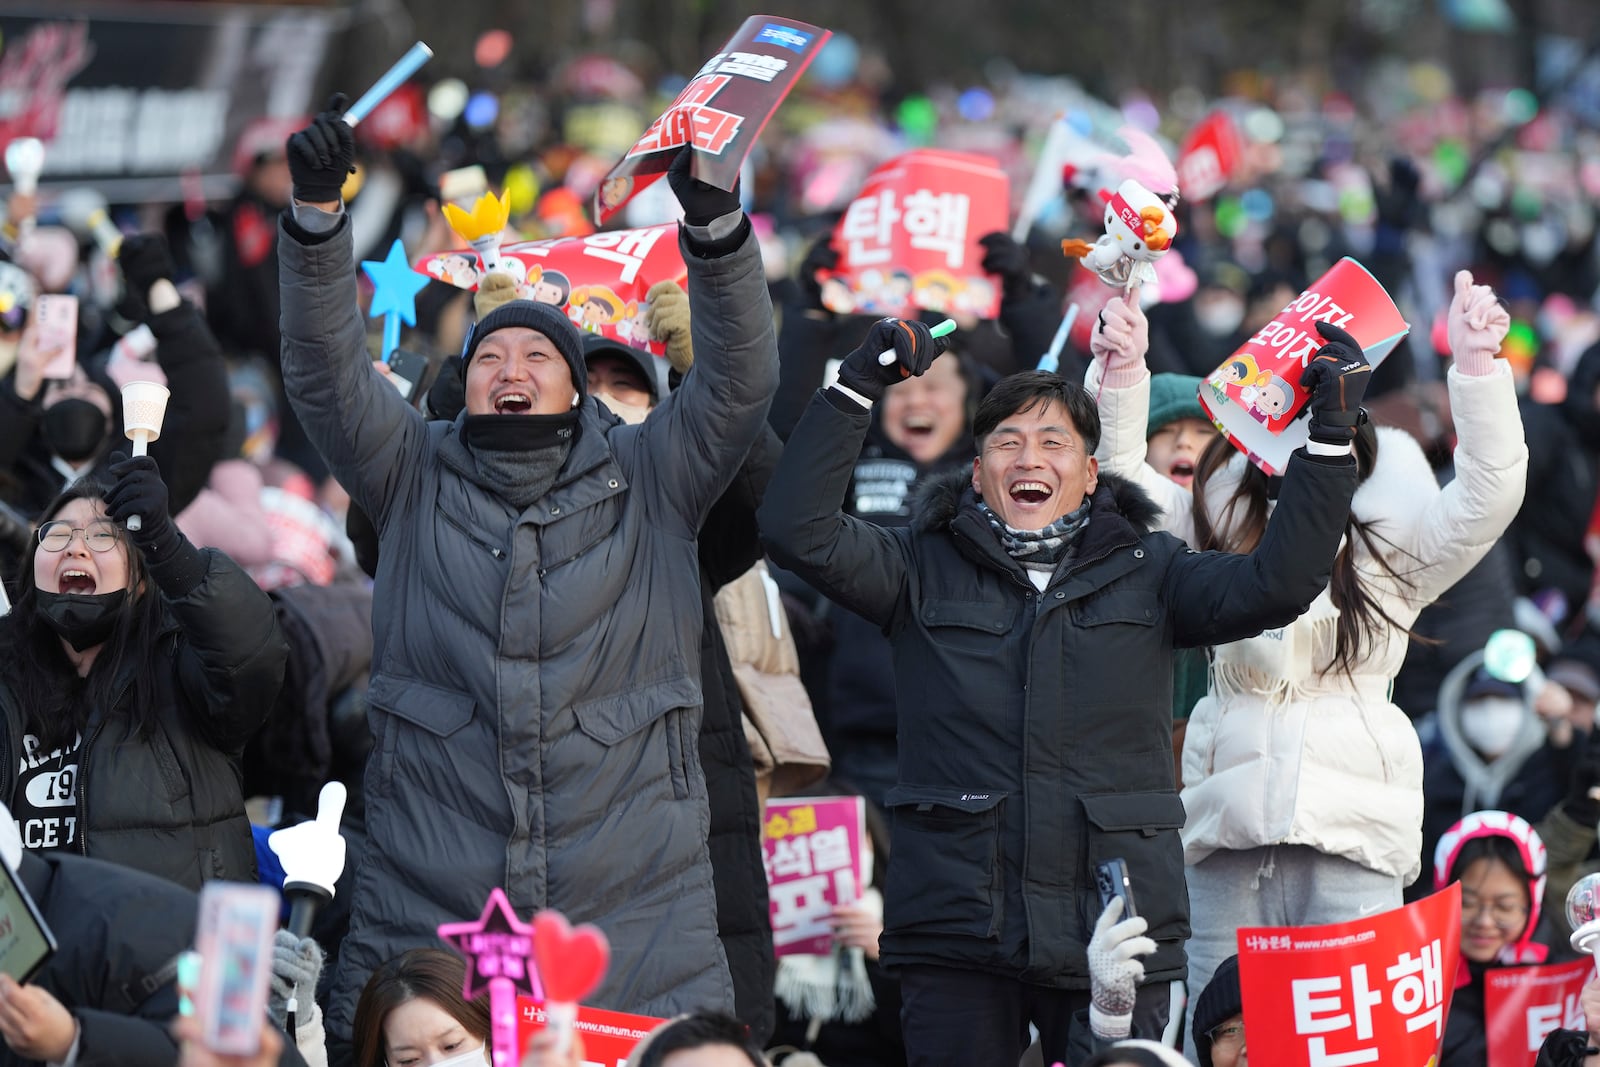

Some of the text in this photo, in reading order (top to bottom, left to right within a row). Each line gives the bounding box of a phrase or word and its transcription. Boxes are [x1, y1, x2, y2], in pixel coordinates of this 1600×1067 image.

[843, 189, 970, 268] 탄핵
[46, 770, 77, 800] 19
[762, 825, 852, 884] 석열
[1294, 930, 1376, 950] www.nanum.com
[1291, 938, 1444, 1067] 탄핵
